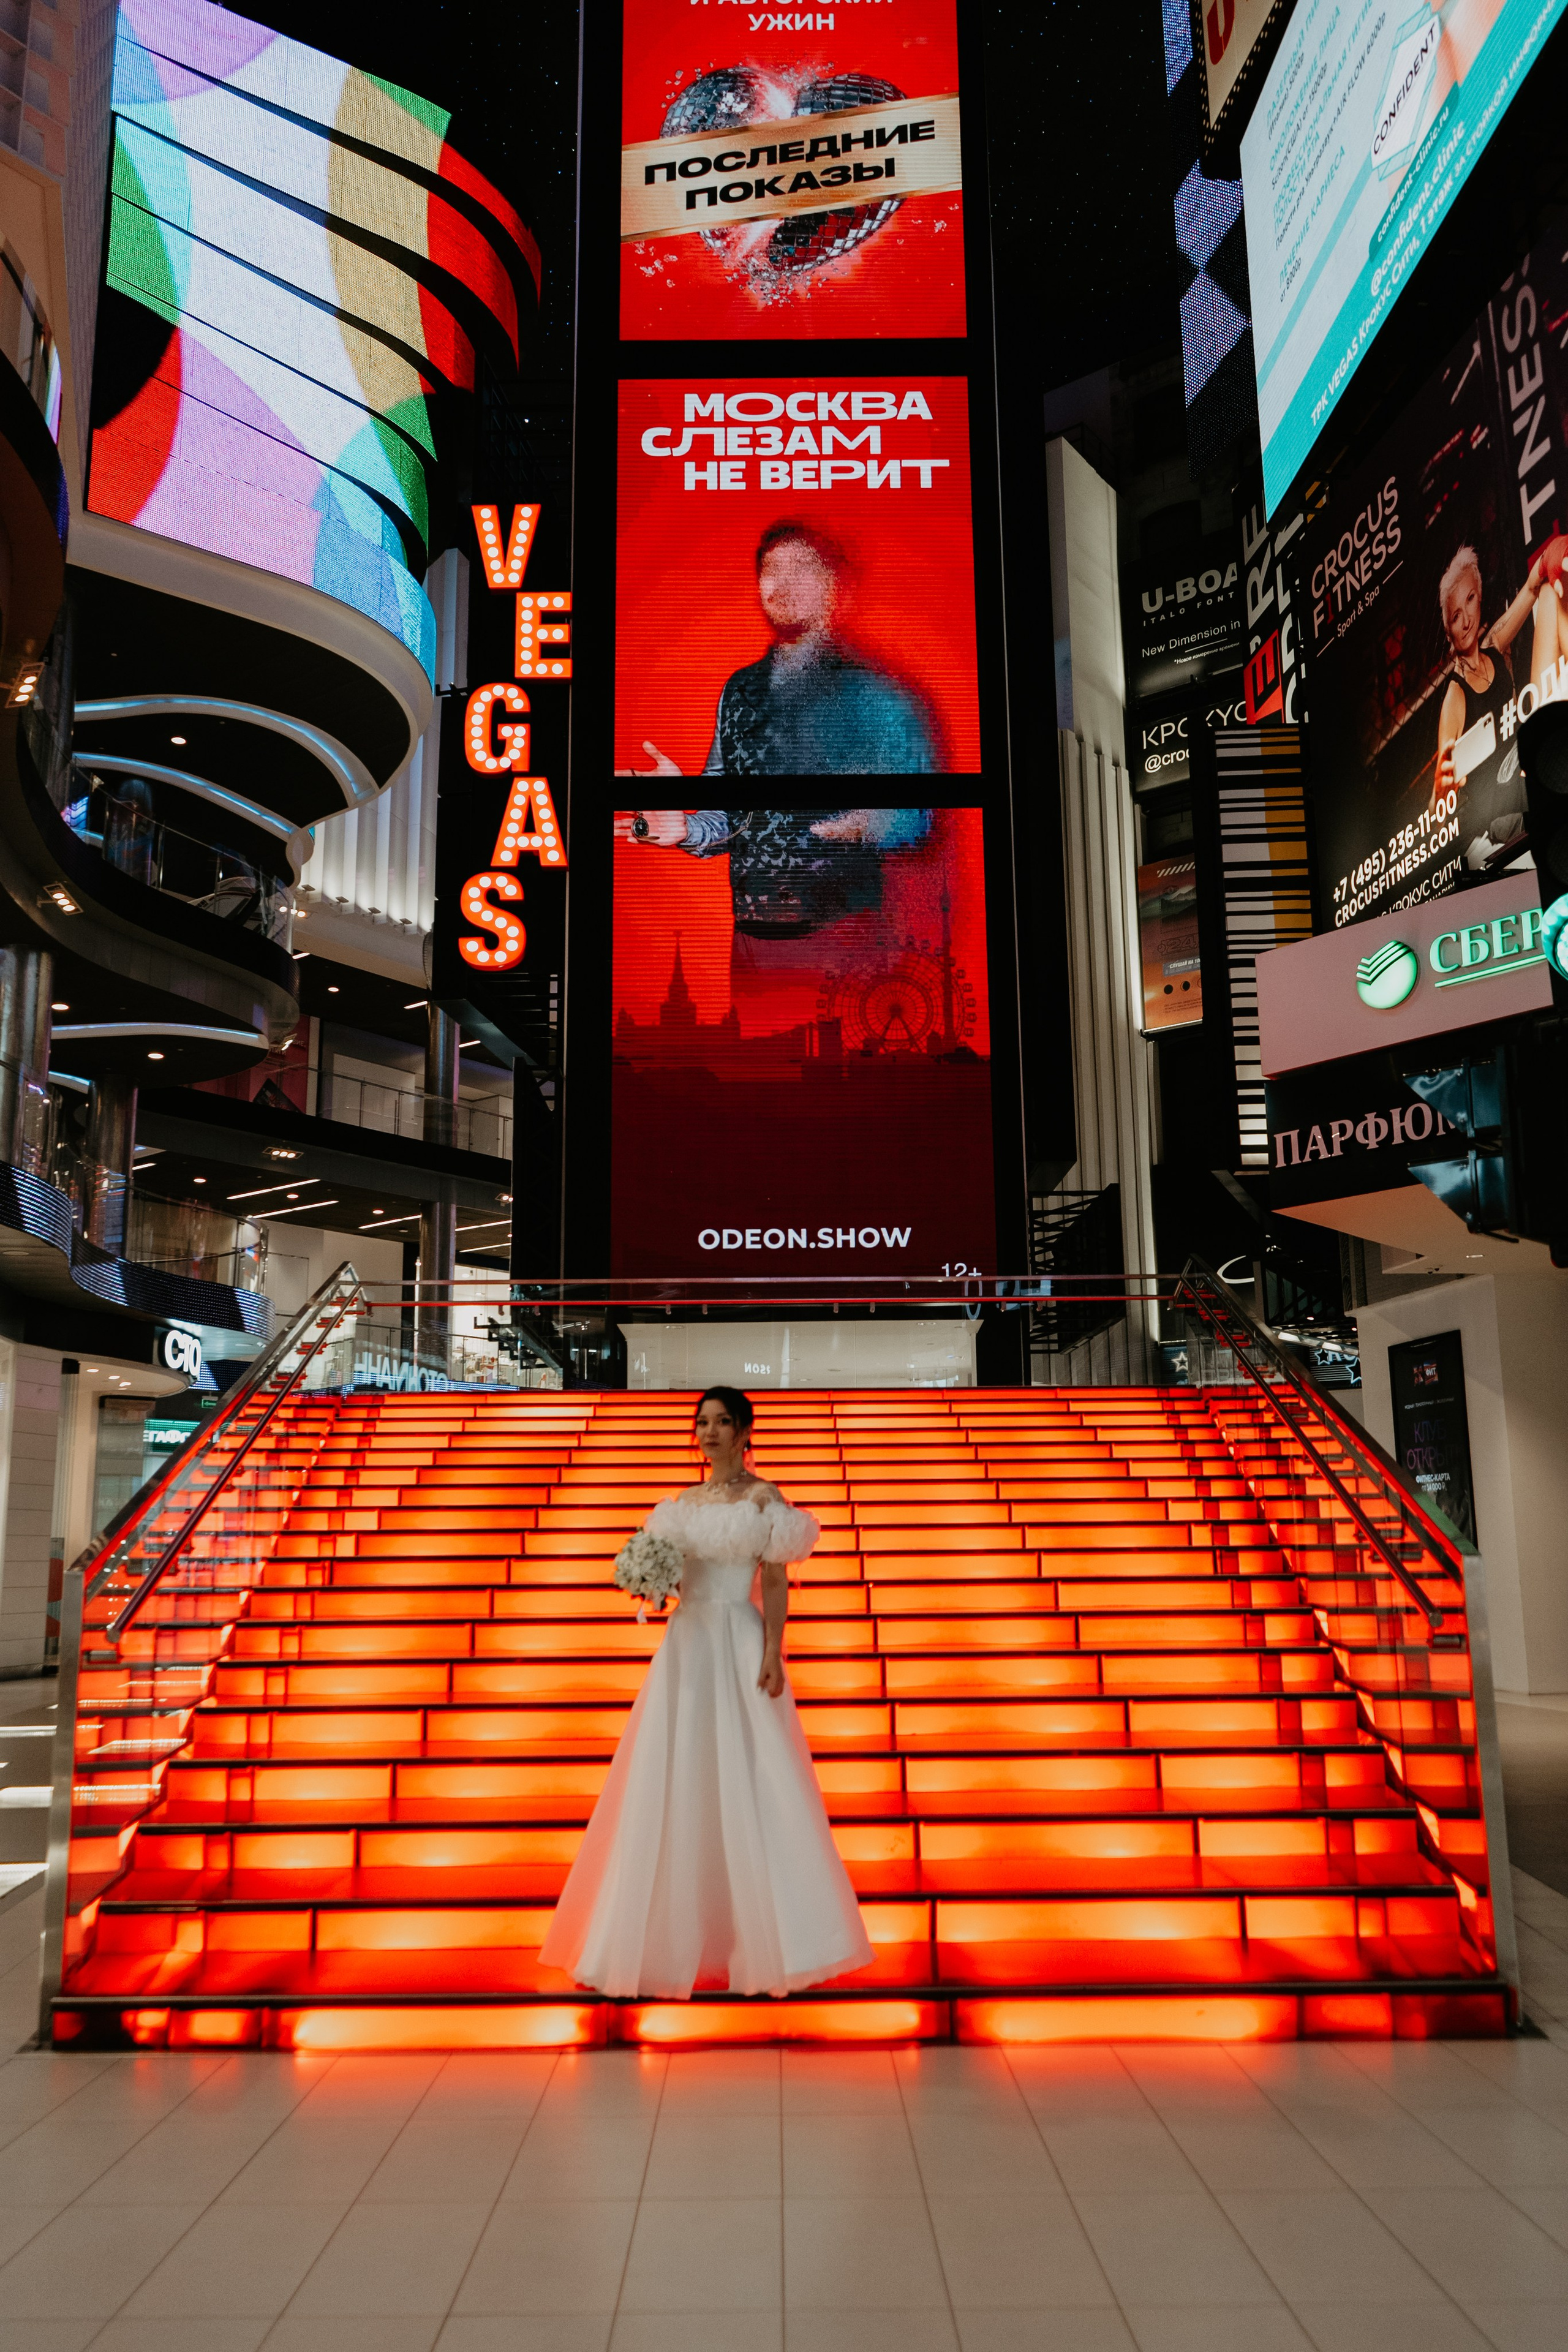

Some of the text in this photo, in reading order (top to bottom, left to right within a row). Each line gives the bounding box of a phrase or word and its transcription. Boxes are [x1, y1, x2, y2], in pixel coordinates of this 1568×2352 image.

[748, 13, 834, 31] УЖИН
[1267, 29, 1304, 127] ЛАЗЕРНЫЙ
[1270, 6, 1340, 172] ОМОЛОЖЕНИЕ ЛИЦА
[1373, 22, 1435, 155] CONFIDENT
[644, 119, 935, 185] ПОСЛЕДНИЕ
[1273, 48, 1346, 219] ПРОФЕССИОНАЛЬНАЯ
[1276, 207, 1296, 251] Полости
[1347, 50, 1366, 96] FLOW
[685, 157, 896, 211] ПОКАЗЫ
[1274, 131, 1321, 233] ПОЛОСТИ РТА
[1377, 107, 1449, 243] confident-clinic.ru
[1280, 145, 1345, 288] ЛЕЧЕНИЕ КАРИЕСА
[1371, 121, 1466, 296] @confident.clinic
[1327, 336, 1359, 397] VEGAS
[684, 391, 933, 422] МОСКВА
[641, 425, 881, 457] СЛЕЗАМ
[684, 459, 950, 491] НЕ ВЕРИТ
[1311, 476, 1398, 598] CROCUS
[1142, 620, 1241, 658] New Dimension in
[1143, 608, 1185, 627] ITALO
[1337, 584, 1380, 638] Sport & Spa
[458, 504, 573, 971] VEGAS
[1333, 876, 1348, 903] +7
[1351, 848, 1385, 894] (495)
[1389, 789, 1457, 863] 236-11-00
[1335, 816, 1460, 928] CROCUSFITNESS.COM
[1432, 855, 1462, 889] СИТИ
[1169, 960, 1188, 968] СЛУШАЙ
[1428, 907, 1544, 973] СБЕР
[698, 1226, 912, 1250] ODEON.SHOW
[941, 1262, 982, 1278] 12+
[1414, 1419, 1447, 1443] КЛУБ
[1415, 1472, 1450, 1483] ФИТНЕС-КАРТА
